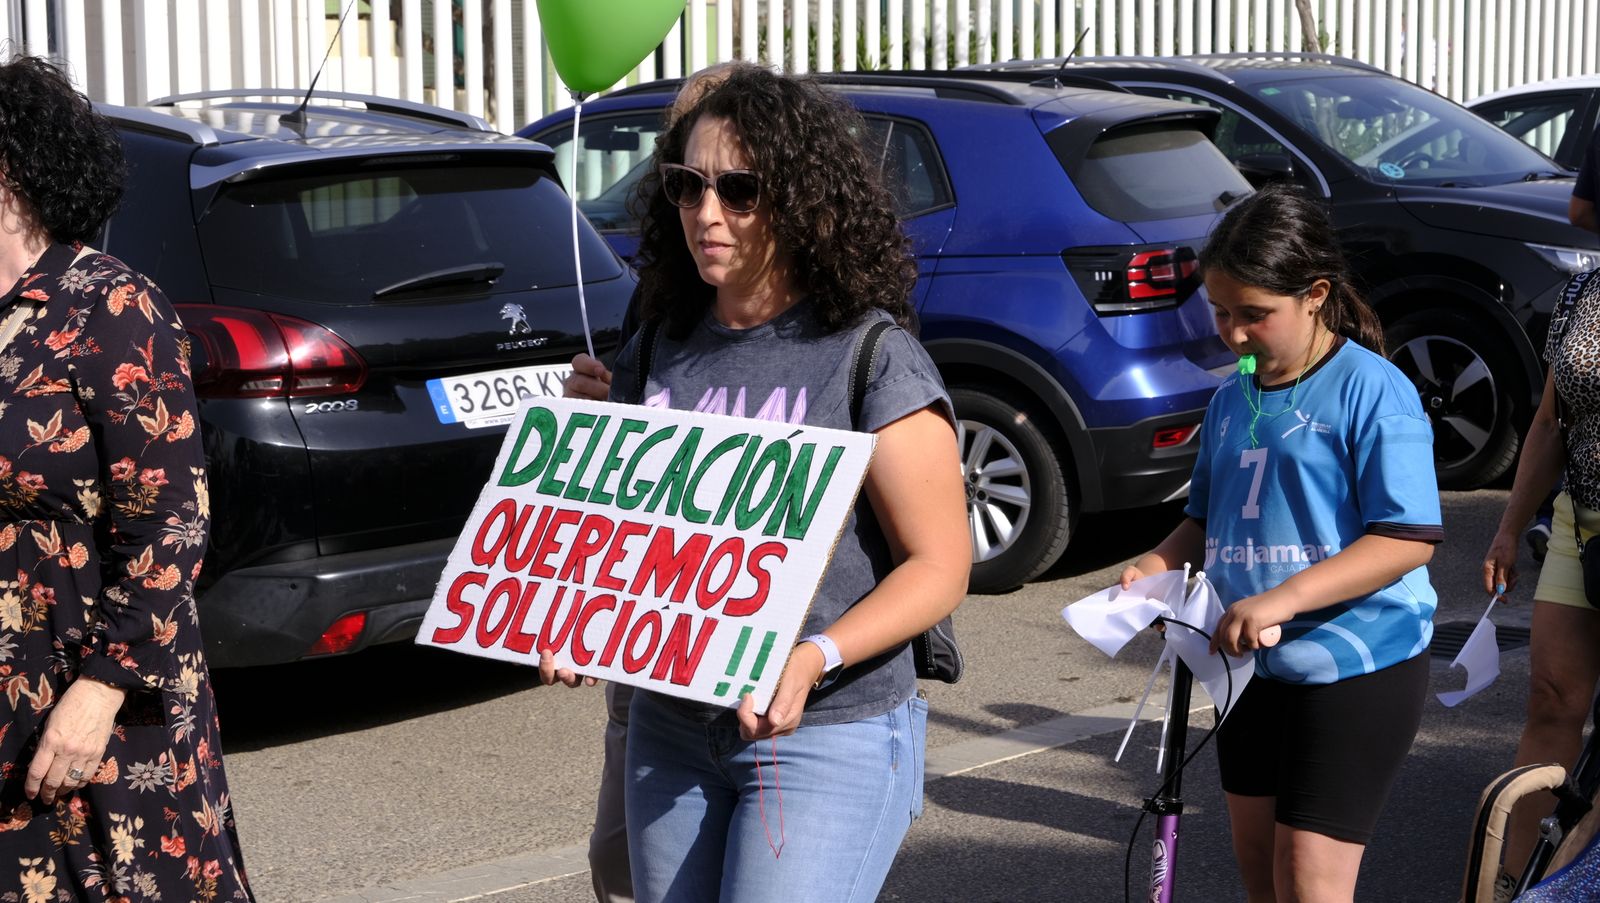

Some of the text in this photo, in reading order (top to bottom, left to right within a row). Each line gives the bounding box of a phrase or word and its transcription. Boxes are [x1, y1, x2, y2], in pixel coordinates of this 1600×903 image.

[496, 337, 548, 350] PEUGEOT
[305, 399, 358, 414] 2008
[440, 405, 449, 415] E
[453, 370, 575, 413] 3266 KY
[497, 406, 845, 540] DELEGACIÓN
[1239, 447, 1268, 519] 7
[471, 498, 788, 617] QUEREMOS
[1220, 538, 1331, 571] cajamar
[432, 571, 718, 687] SOLUCIÓN
